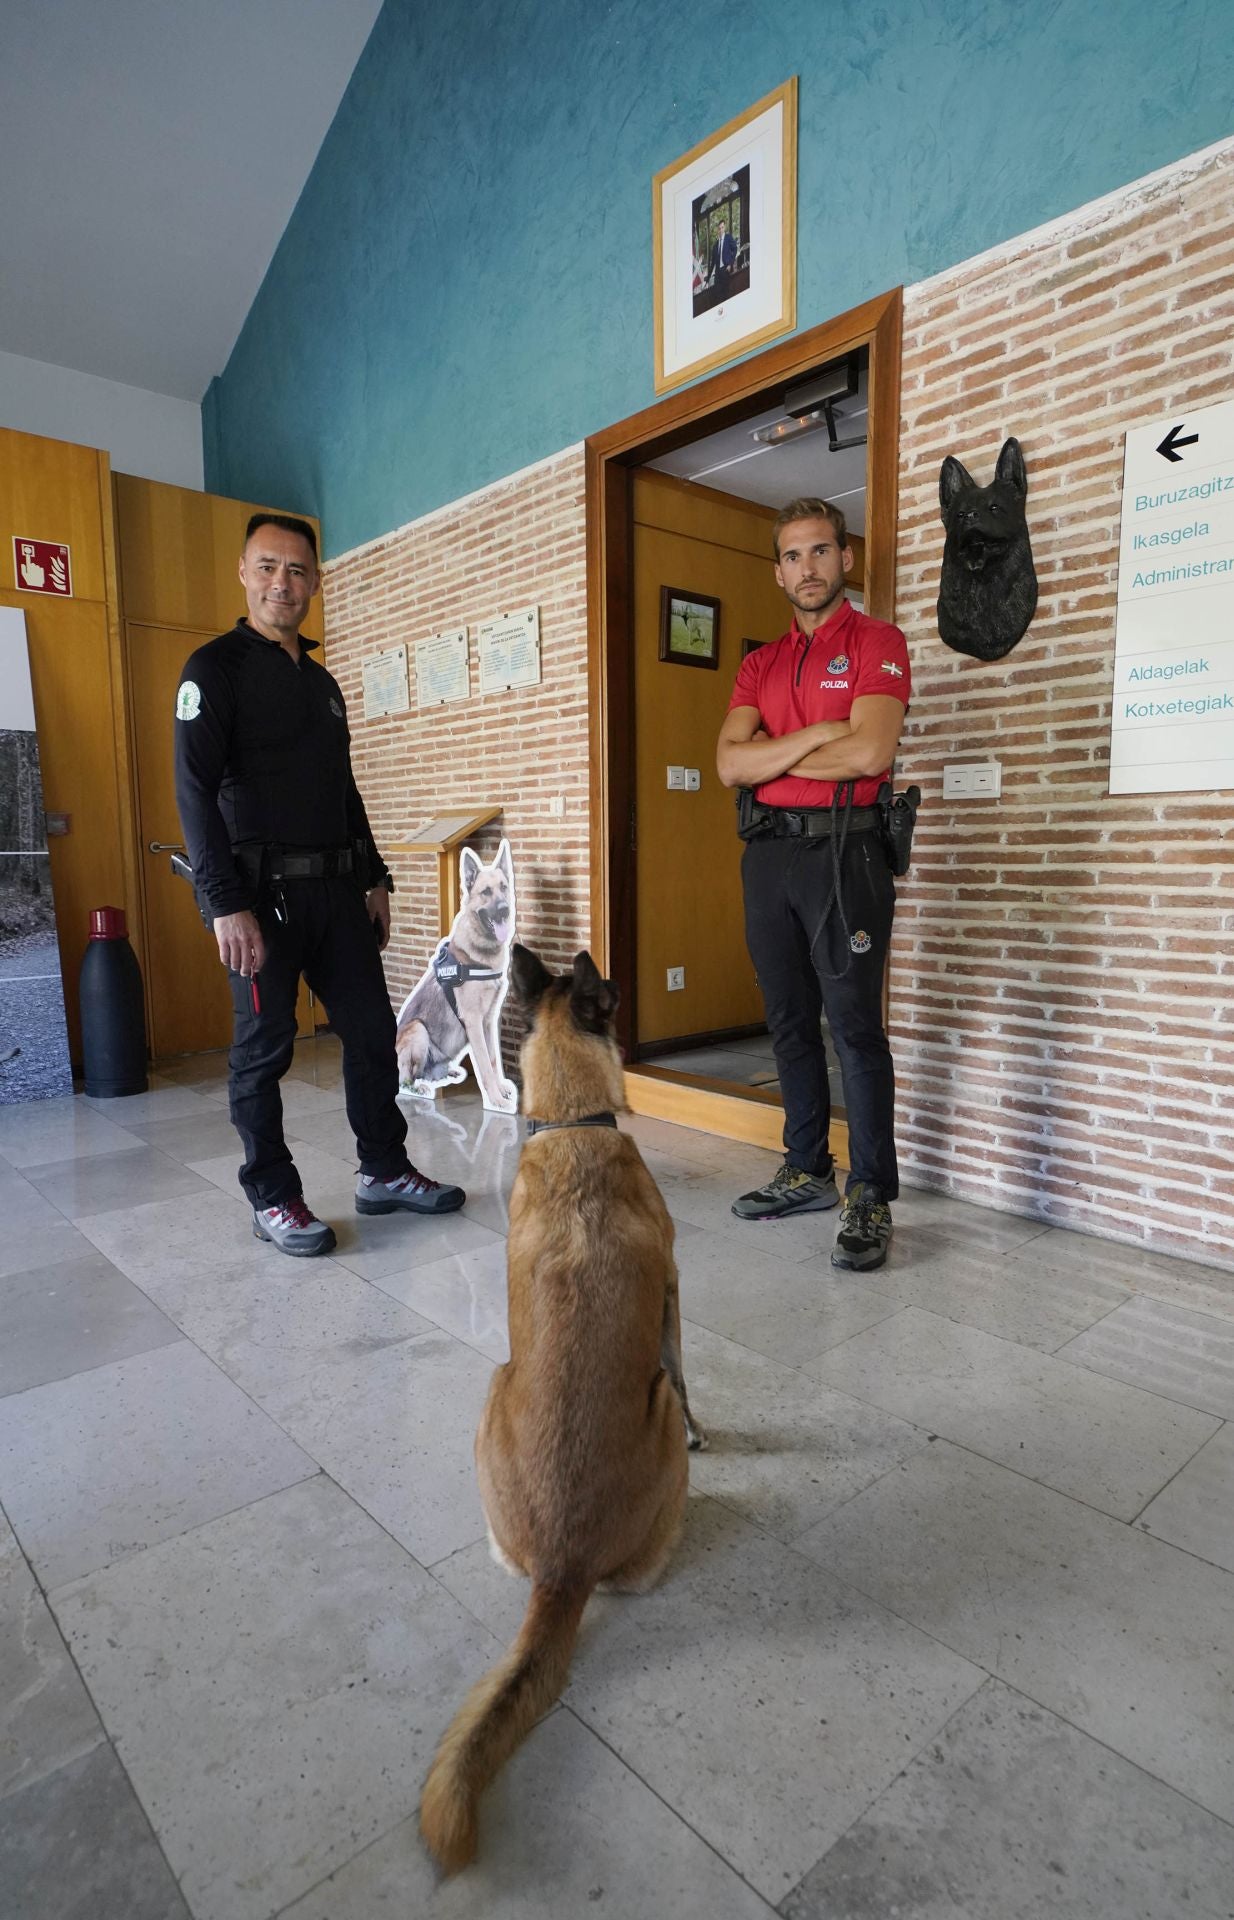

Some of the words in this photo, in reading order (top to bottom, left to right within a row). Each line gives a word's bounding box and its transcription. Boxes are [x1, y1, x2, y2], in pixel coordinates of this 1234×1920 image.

[1133, 521, 1209, 550] Ikasgela
[1128, 658, 1209, 682] Aldagelak
[820, 680, 848, 689] POLIZIA
[1125, 693, 1234, 718] Kotxetegiak
